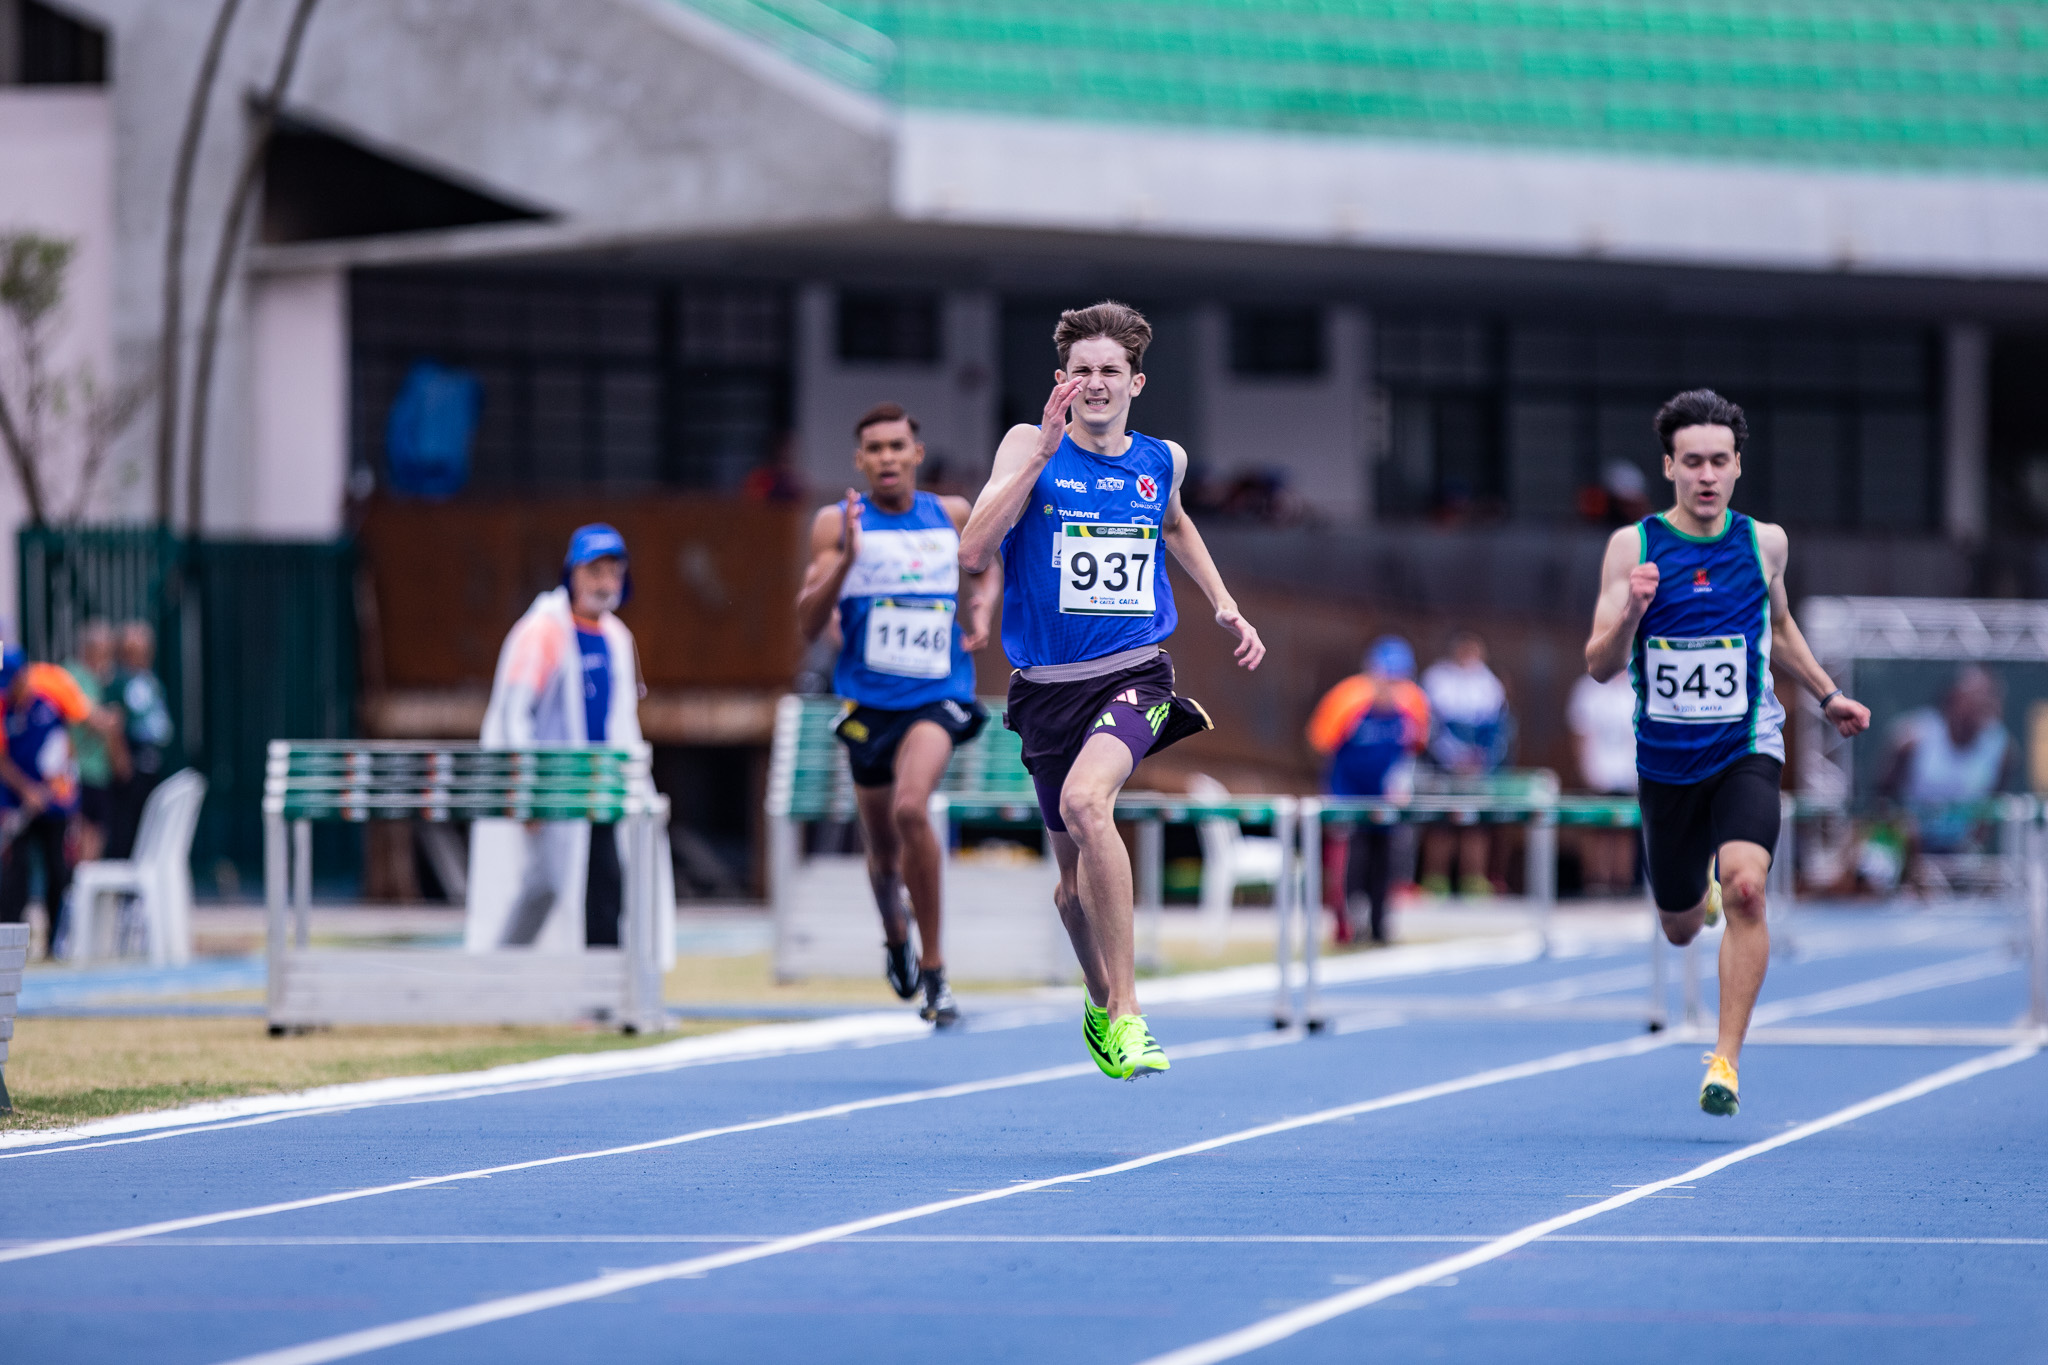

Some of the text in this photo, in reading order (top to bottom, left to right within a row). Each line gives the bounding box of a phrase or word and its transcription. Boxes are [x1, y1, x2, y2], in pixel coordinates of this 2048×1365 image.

[1070, 551, 1150, 592] 937
[878, 623, 946, 652] 1146
[1655, 663, 1739, 699] 543
